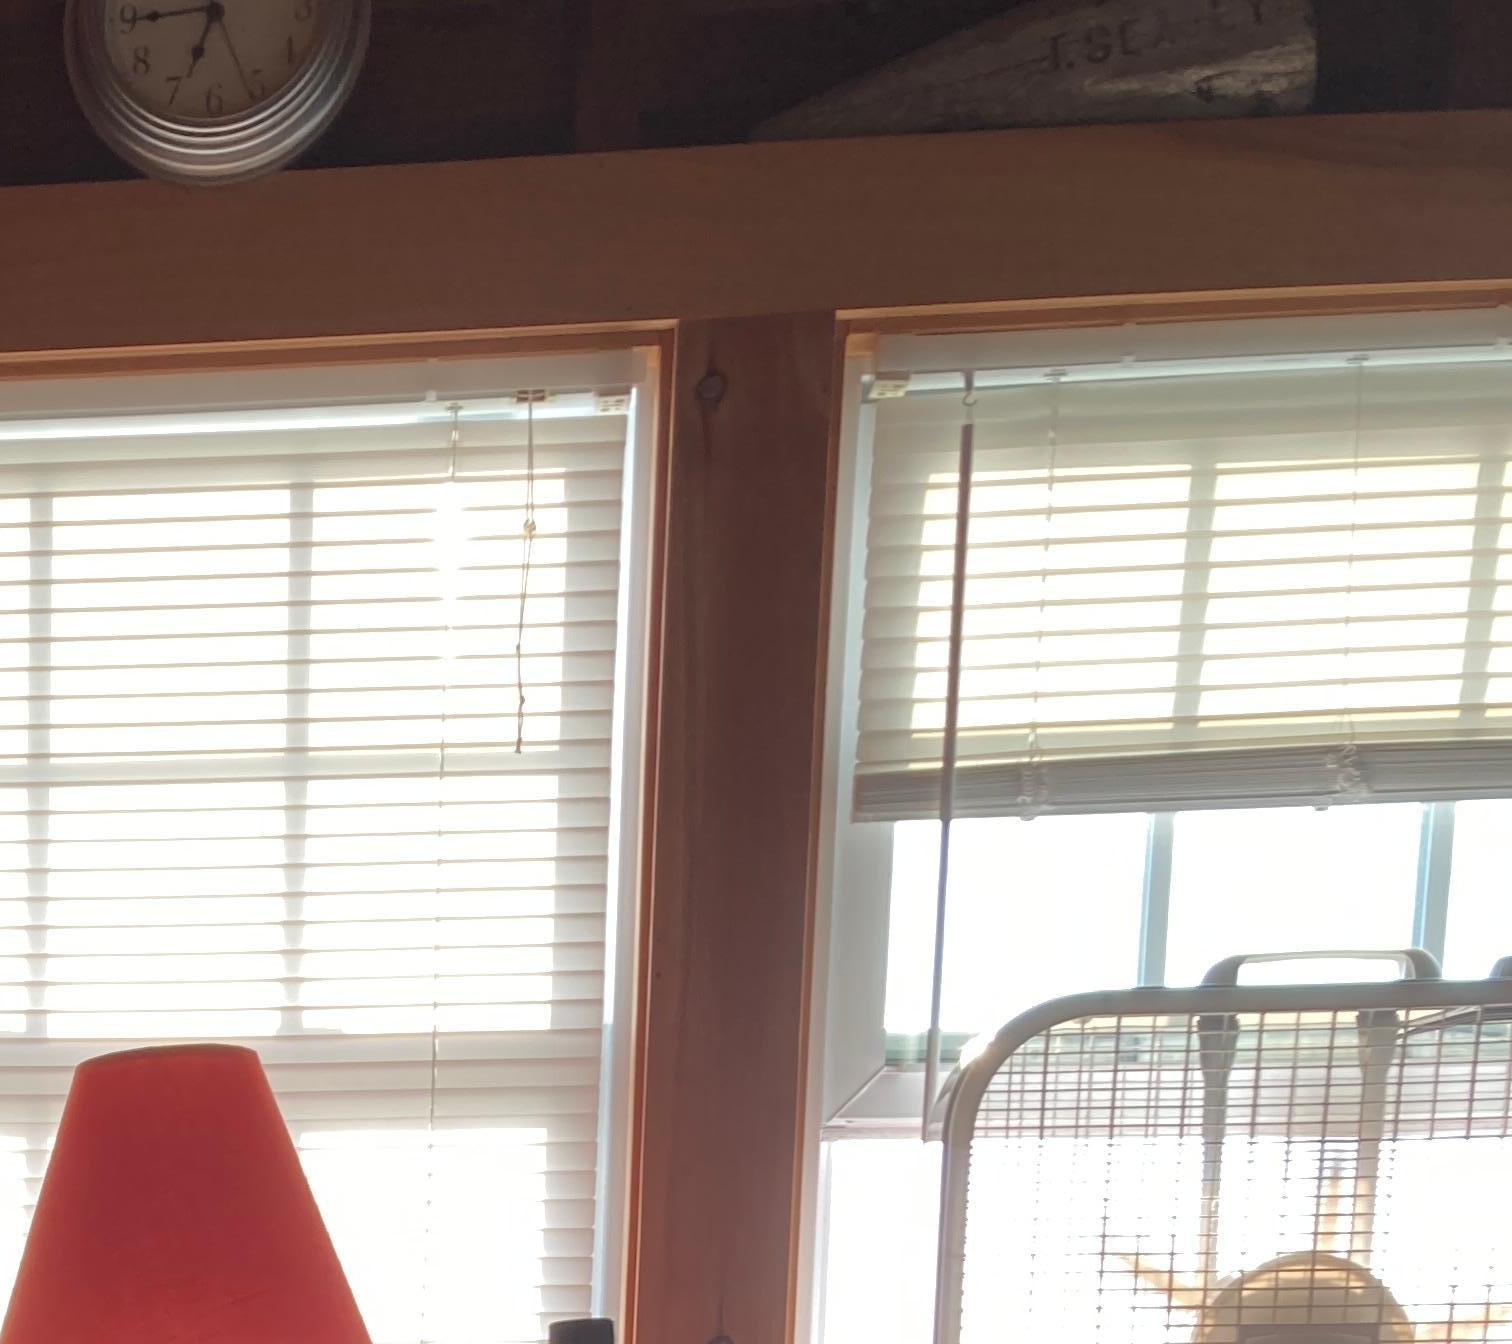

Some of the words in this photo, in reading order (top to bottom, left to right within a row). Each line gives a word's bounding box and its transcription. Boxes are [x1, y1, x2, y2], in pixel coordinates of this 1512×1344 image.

[120, 4, 137, 34] 9
[132, 45, 151, 75] 8
[166, 76, 183, 106] 7
[205, 82, 224, 113] 6
